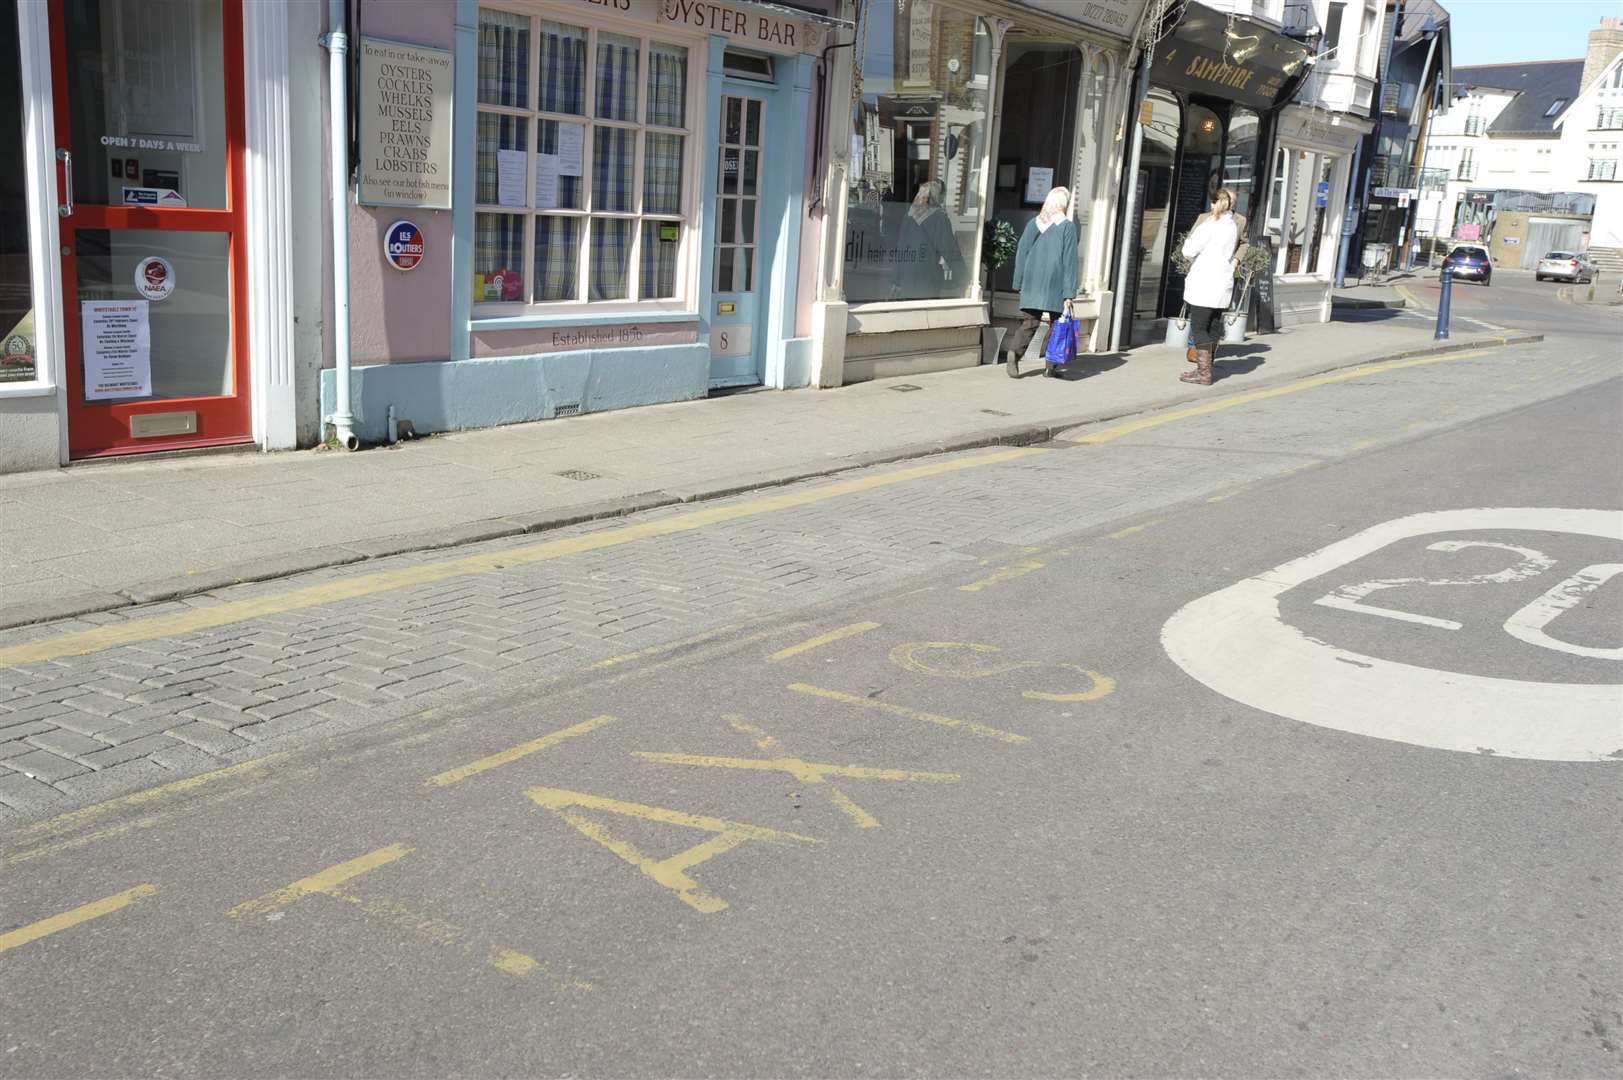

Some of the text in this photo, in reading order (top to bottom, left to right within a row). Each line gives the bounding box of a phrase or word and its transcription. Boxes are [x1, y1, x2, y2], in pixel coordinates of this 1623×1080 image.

[759, 17, 795, 47] BAR
[374, 48, 387, 57] eat
[388, 49, 396, 59] in
[396, 52, 406, 60] or
[407, 52, 450, 69] take-away
[380, 63, 432, 81] OYSTERS
[1185, 55, 1255, 90] SAMPHIRE
[377, 77, 433, 95] COCKLES
[380, 91, 432, 108] WHELKS
[377, 103, 433, 122] MUSSELS
[392, 119, 422, 134] EELS
[100, 136, 128, 147] OPEN
[131, 138, 137, 148] 7
[139, 139, 166, 150] DAYS
[166, 142, 174, 151] A
[380, 131, 431, 148] PRAWNS
[383, 145, 428, 161] CRABS
[375, 158, 438, 175] LOBSTERS
[379, 179, 391, 187] see
[390, 242, 423, 254] ROUTIERS
[552, 328, 614, 346] Established
[720, 331, 728, 350] 8
[225, 641, 1117, 991] TAXIS
